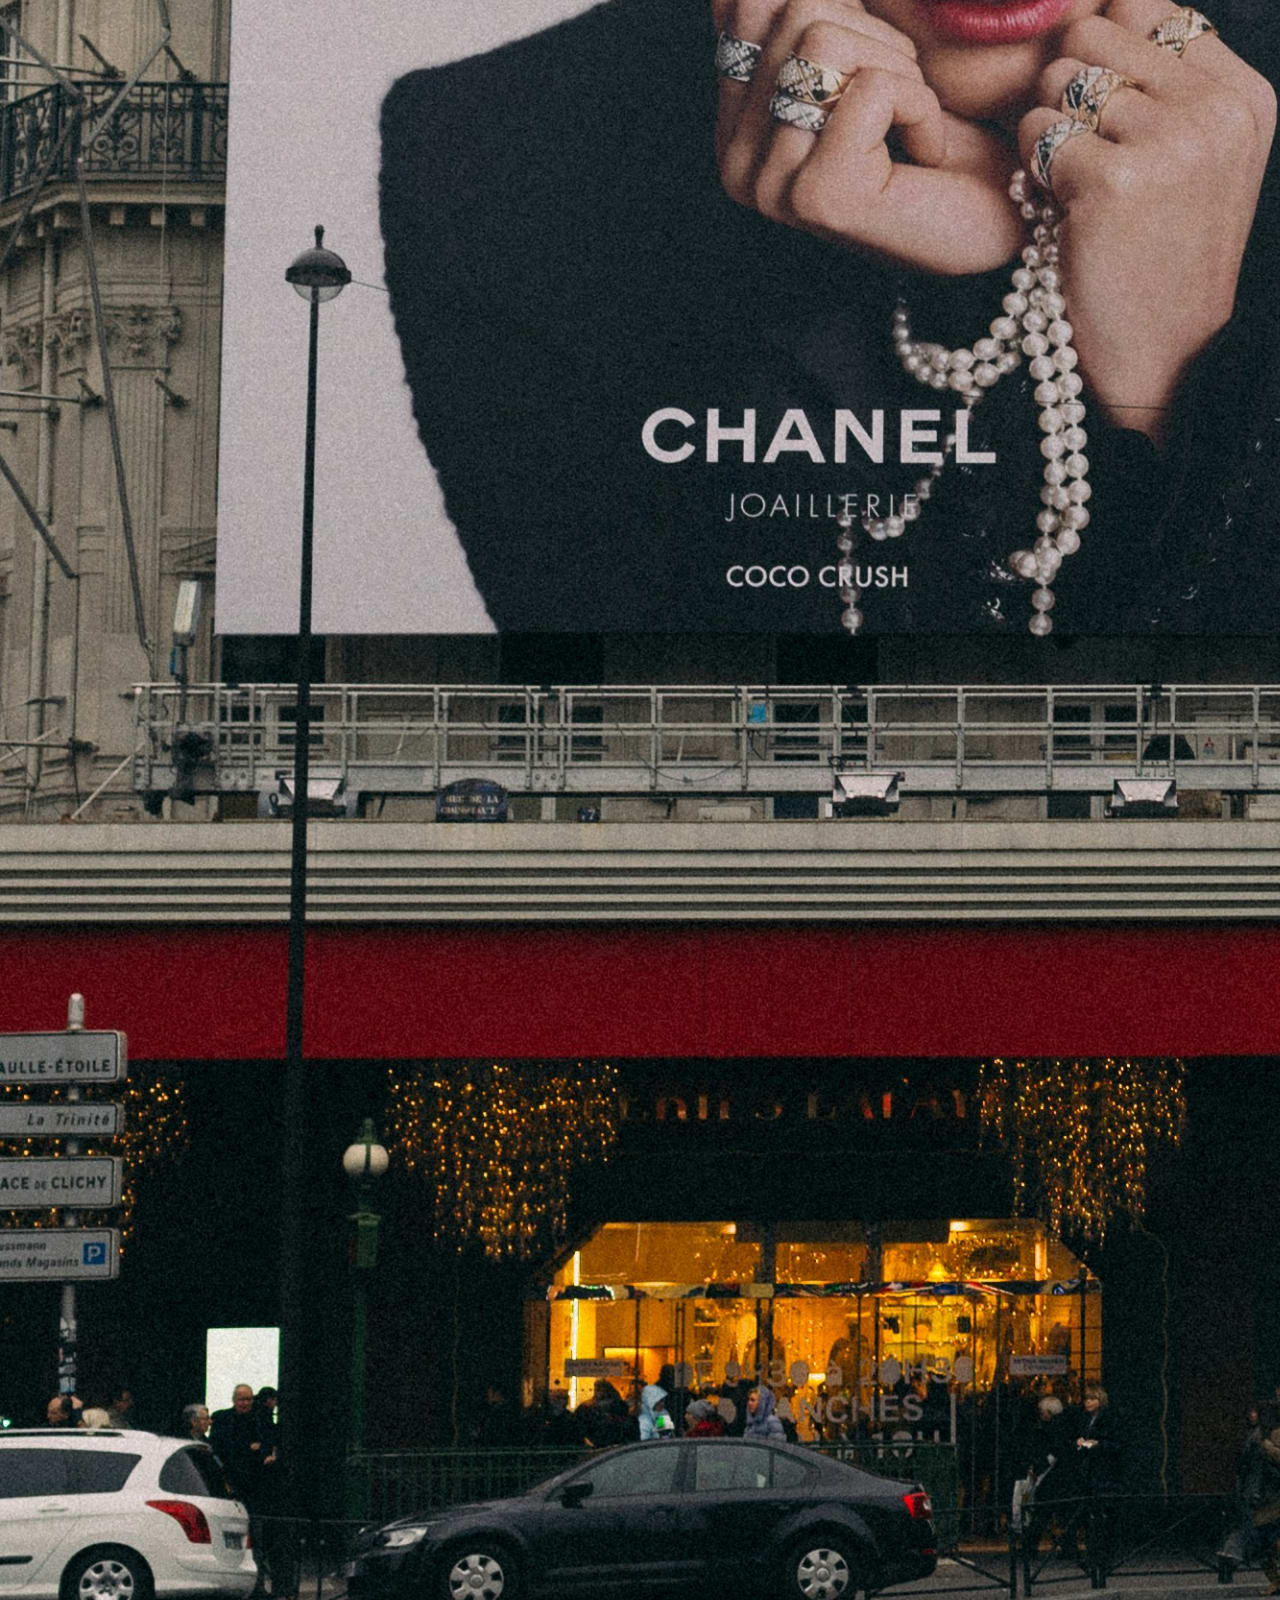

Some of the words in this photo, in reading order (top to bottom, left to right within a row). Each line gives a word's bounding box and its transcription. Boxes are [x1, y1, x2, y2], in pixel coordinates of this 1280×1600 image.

[641, 407, 997, 464] CHANEL
[725, 493, 918, 521] JOAILLERIE
[726, 565, 809, 588] COCO
[818, 565, 909, 588] CRUSH
[27, 1113, 45, 1126] La
[51, 1176, 107, 1189] CLICHY
